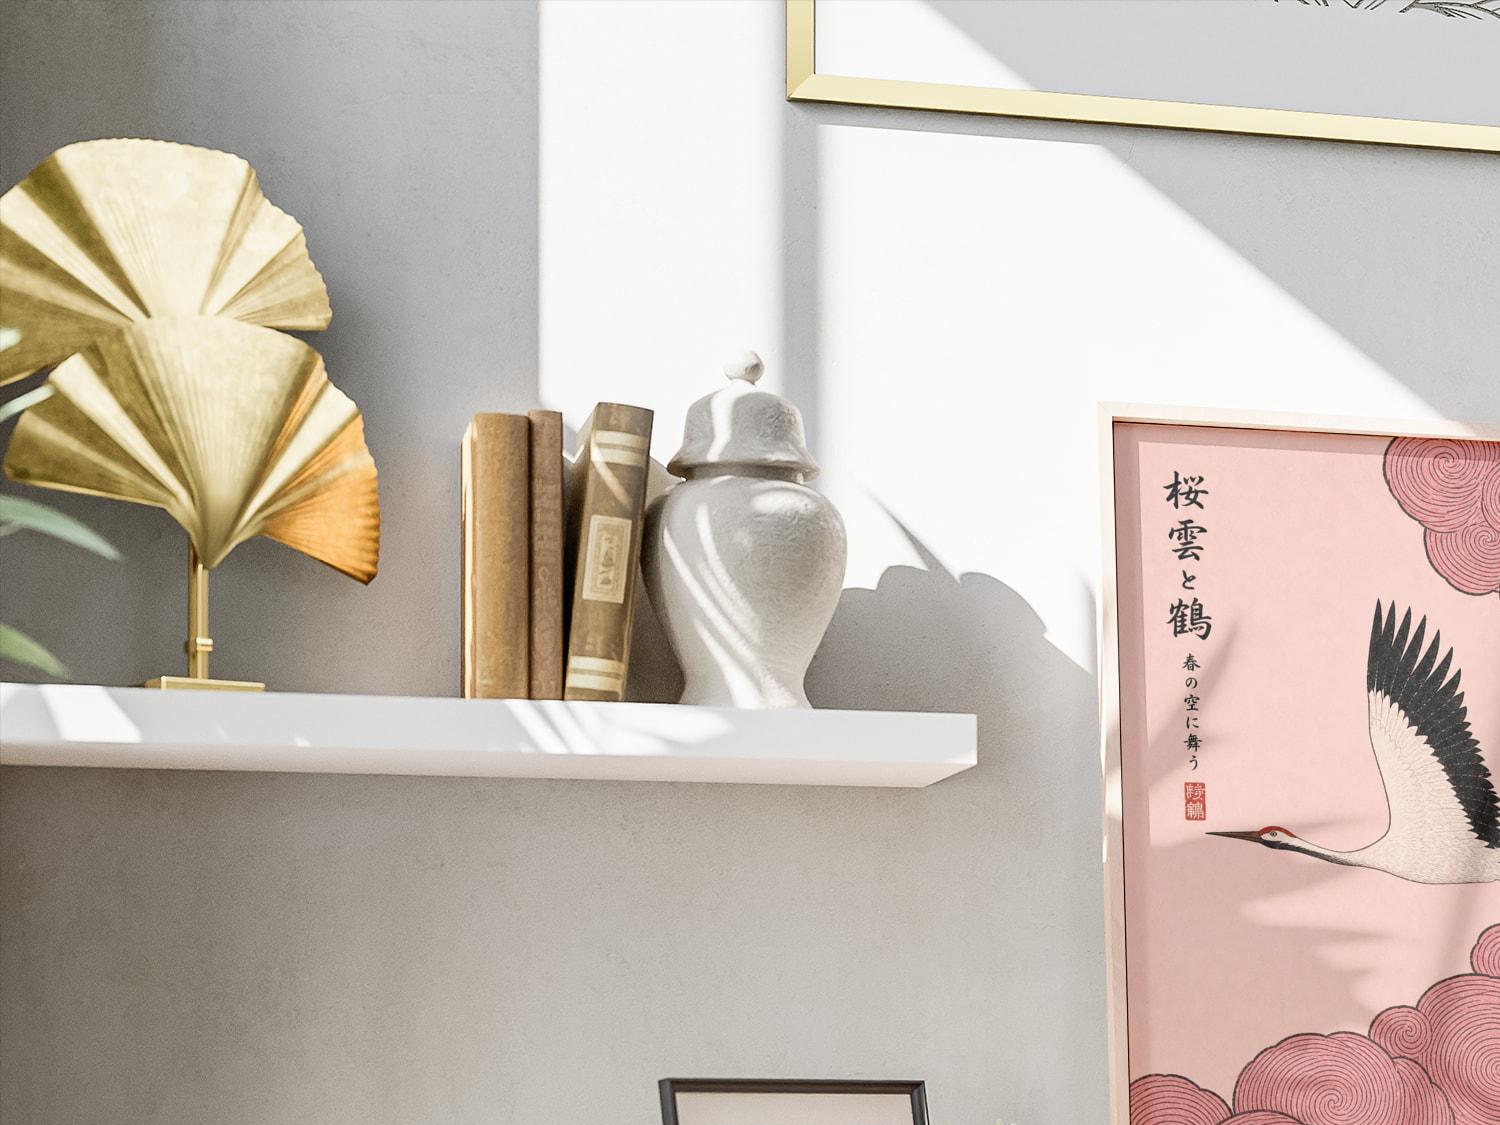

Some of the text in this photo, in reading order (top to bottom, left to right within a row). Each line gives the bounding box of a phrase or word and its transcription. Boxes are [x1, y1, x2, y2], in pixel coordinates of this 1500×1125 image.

[1162, 470, 1213, 641] 桜雲と鶴
[1182, 652, 1203, 772] 春の空に舞う
